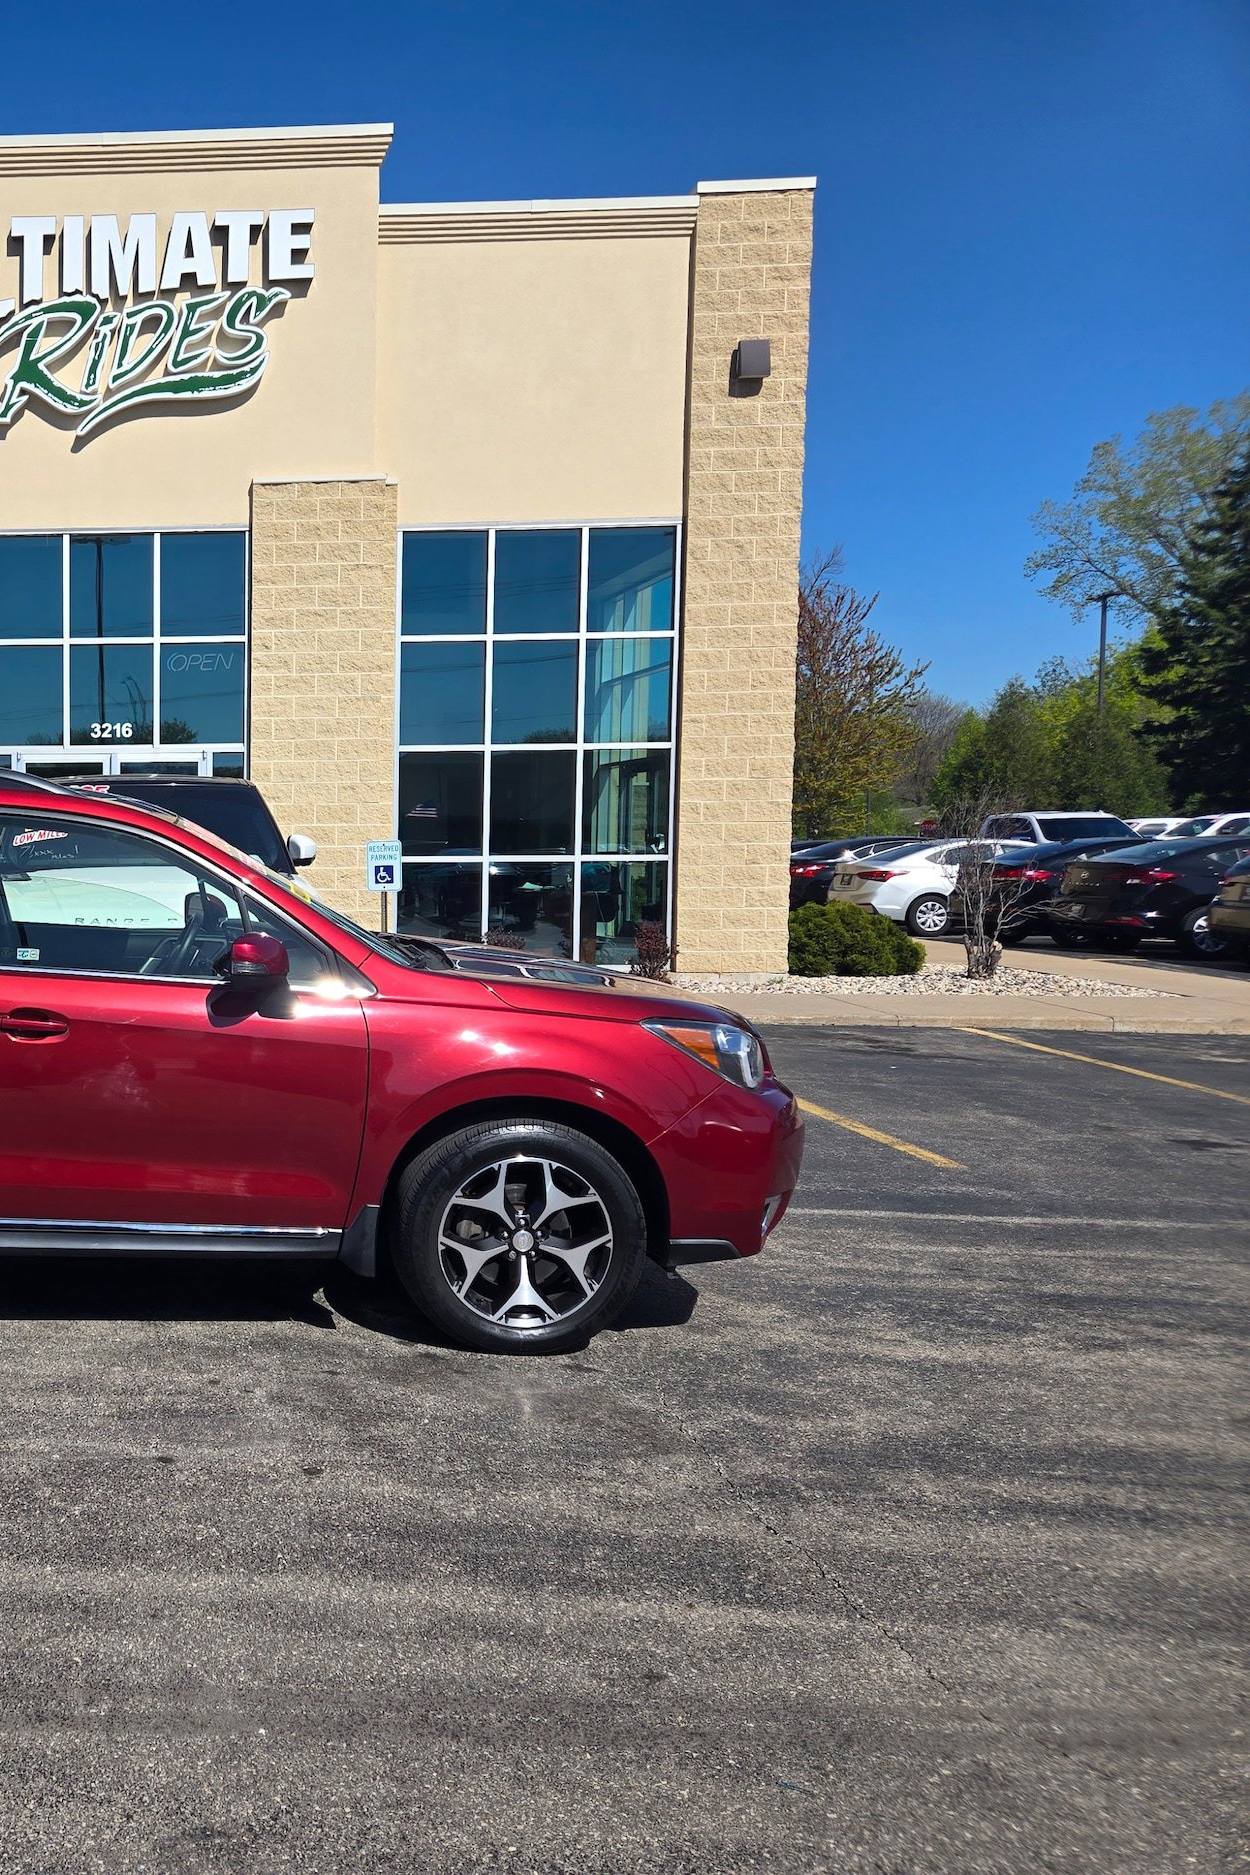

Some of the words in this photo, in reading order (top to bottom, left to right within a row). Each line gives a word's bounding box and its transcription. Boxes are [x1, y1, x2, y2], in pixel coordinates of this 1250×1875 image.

[167, 652, 234, 672] OPEN
[90, 722, 133, 738] 3216
[14, 831, 34, 845] LOW
[74, 917, 150, 925] RANGE
